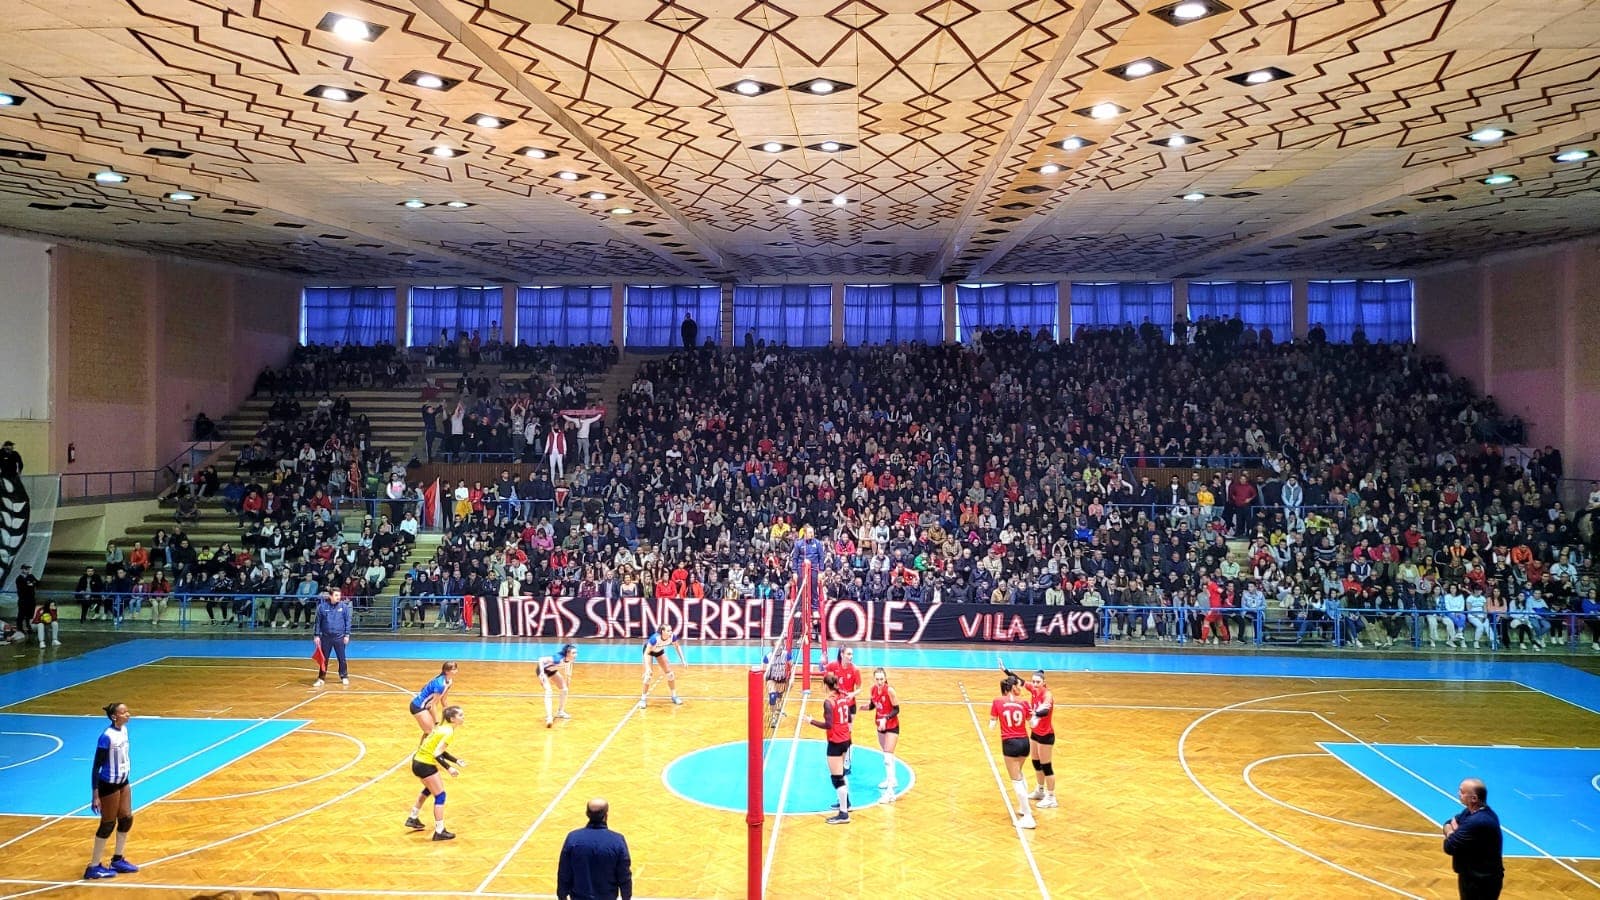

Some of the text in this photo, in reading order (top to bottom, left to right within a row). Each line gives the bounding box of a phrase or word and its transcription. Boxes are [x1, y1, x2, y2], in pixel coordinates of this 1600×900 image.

[958, 610, 1095, 641] VILA LAKO
[837, 704, 849, 725] 13
[1002, 709, 1023, 728] 19
